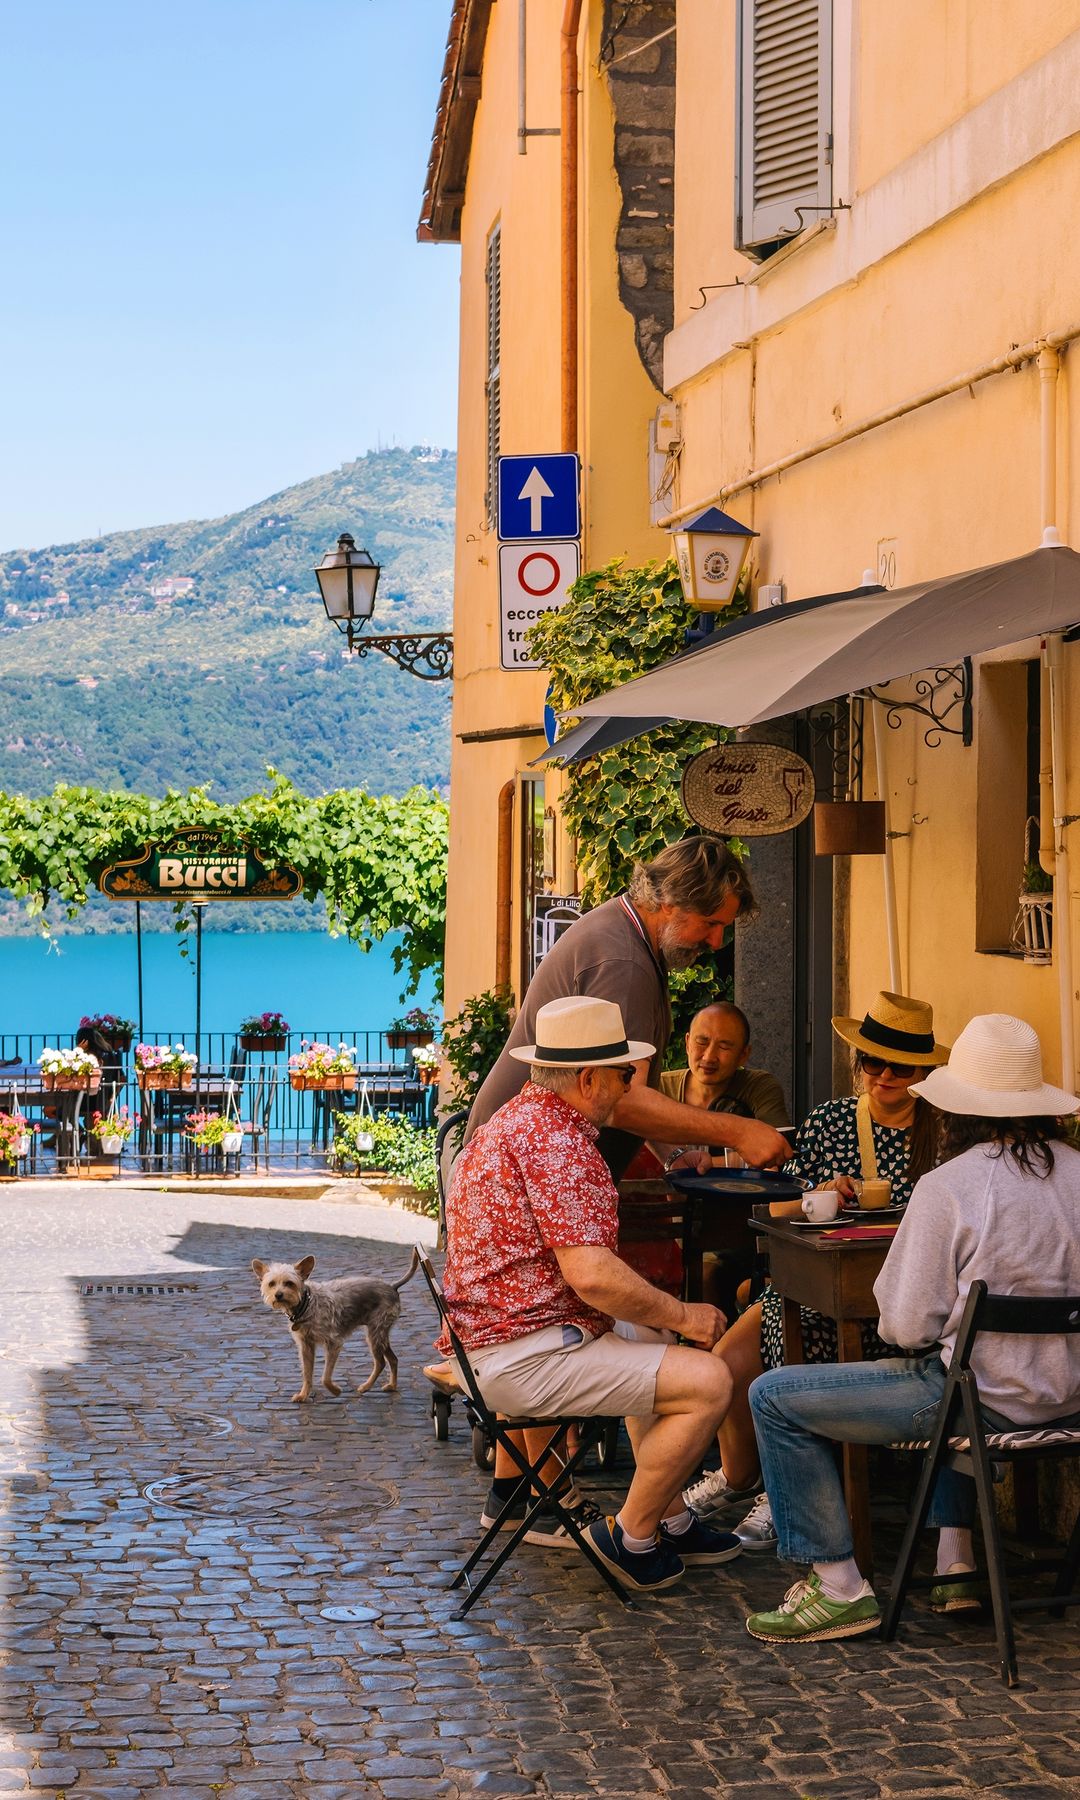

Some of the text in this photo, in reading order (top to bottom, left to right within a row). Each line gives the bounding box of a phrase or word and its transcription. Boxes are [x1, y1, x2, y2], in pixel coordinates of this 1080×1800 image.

[507, 605, 560, 620] eccett
[705, 756, 757, 774] Amici
[714, 778, 743, 796] del
[722, 801, 771, 826] Gusto
[183, 857, 238, 865] RISTORANTE
[158, 859, 246, 887] Bucci
[556, 899, 564, 907] di
[565, 899, 581, 907] Lillo
